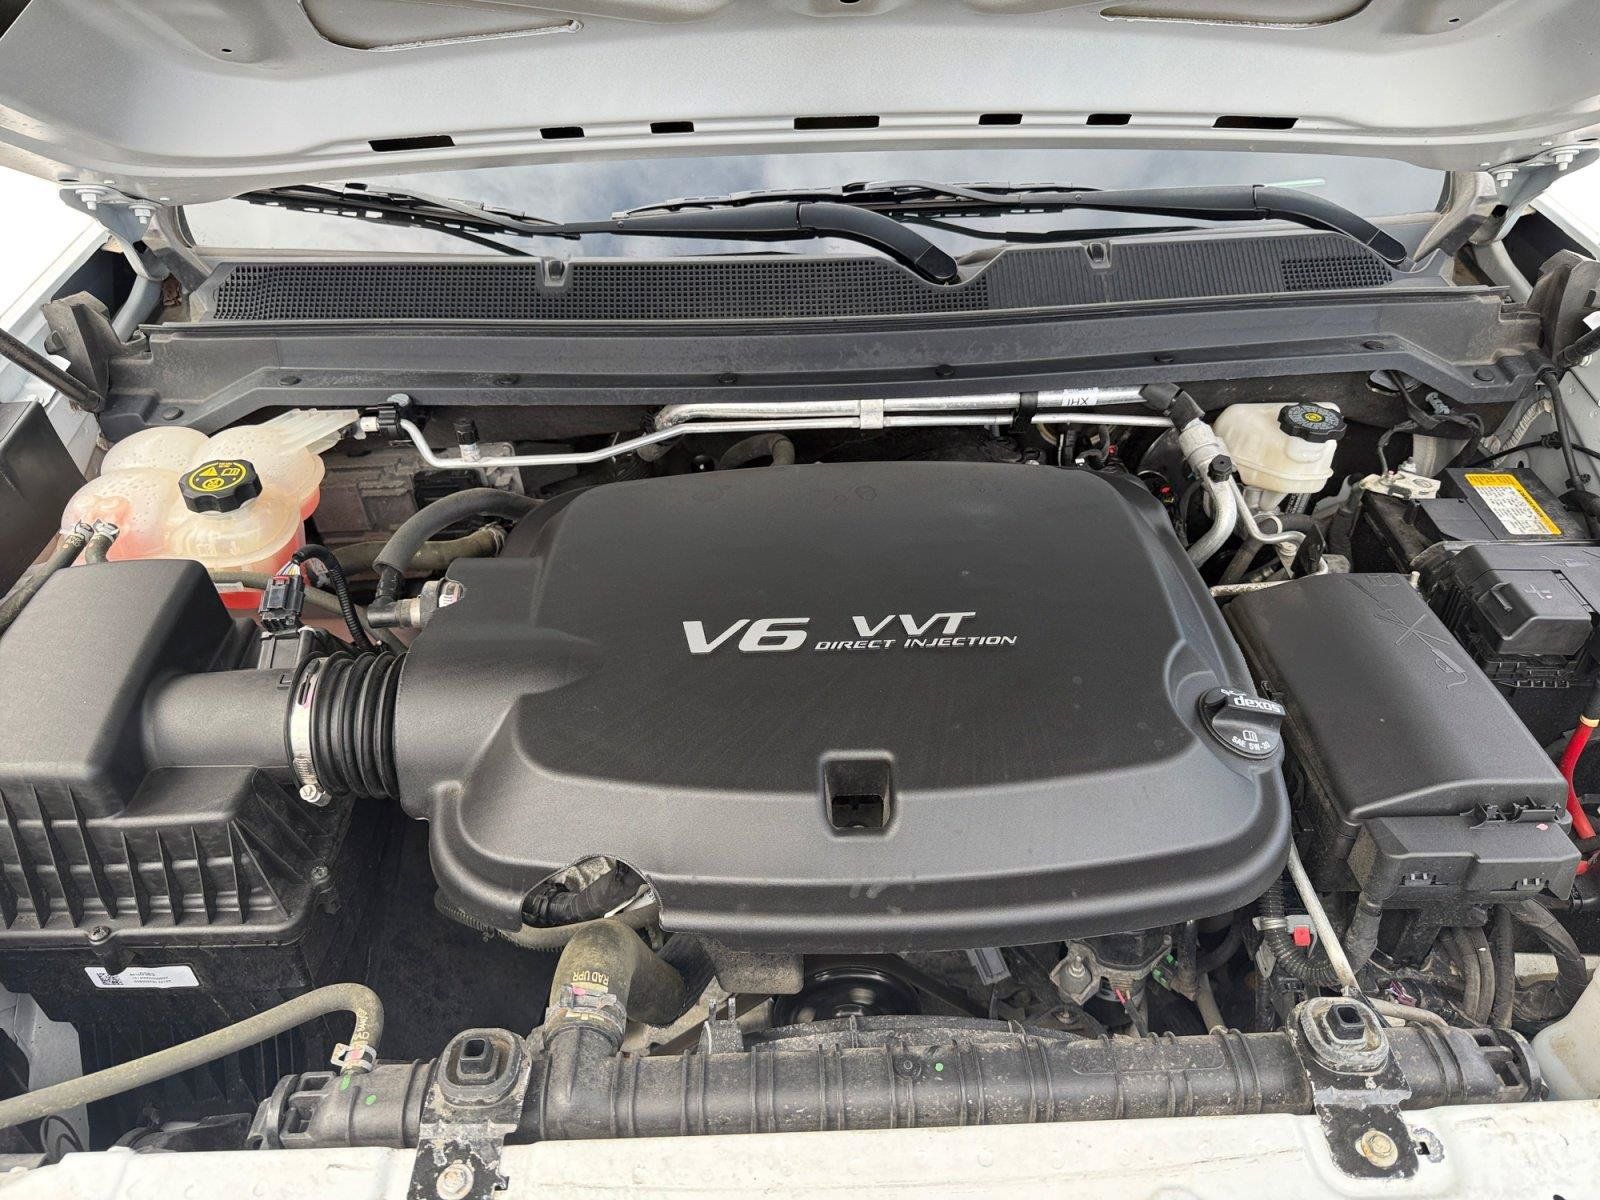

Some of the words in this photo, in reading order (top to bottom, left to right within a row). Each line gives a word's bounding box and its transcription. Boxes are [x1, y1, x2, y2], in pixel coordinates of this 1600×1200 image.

[852, 612, 976, 637] VVT
[682, 617, 810, 654] V6
[814, 639, 896, 650] DIRECT
[904, 635, 1017, 649] INJECTION
[1233, 695, 1282, 713] dexos
[1231, 735, 1247, 748] SAE
[572, 970, 590, 983] UPR
[592, 971, 610, 986] RAD
